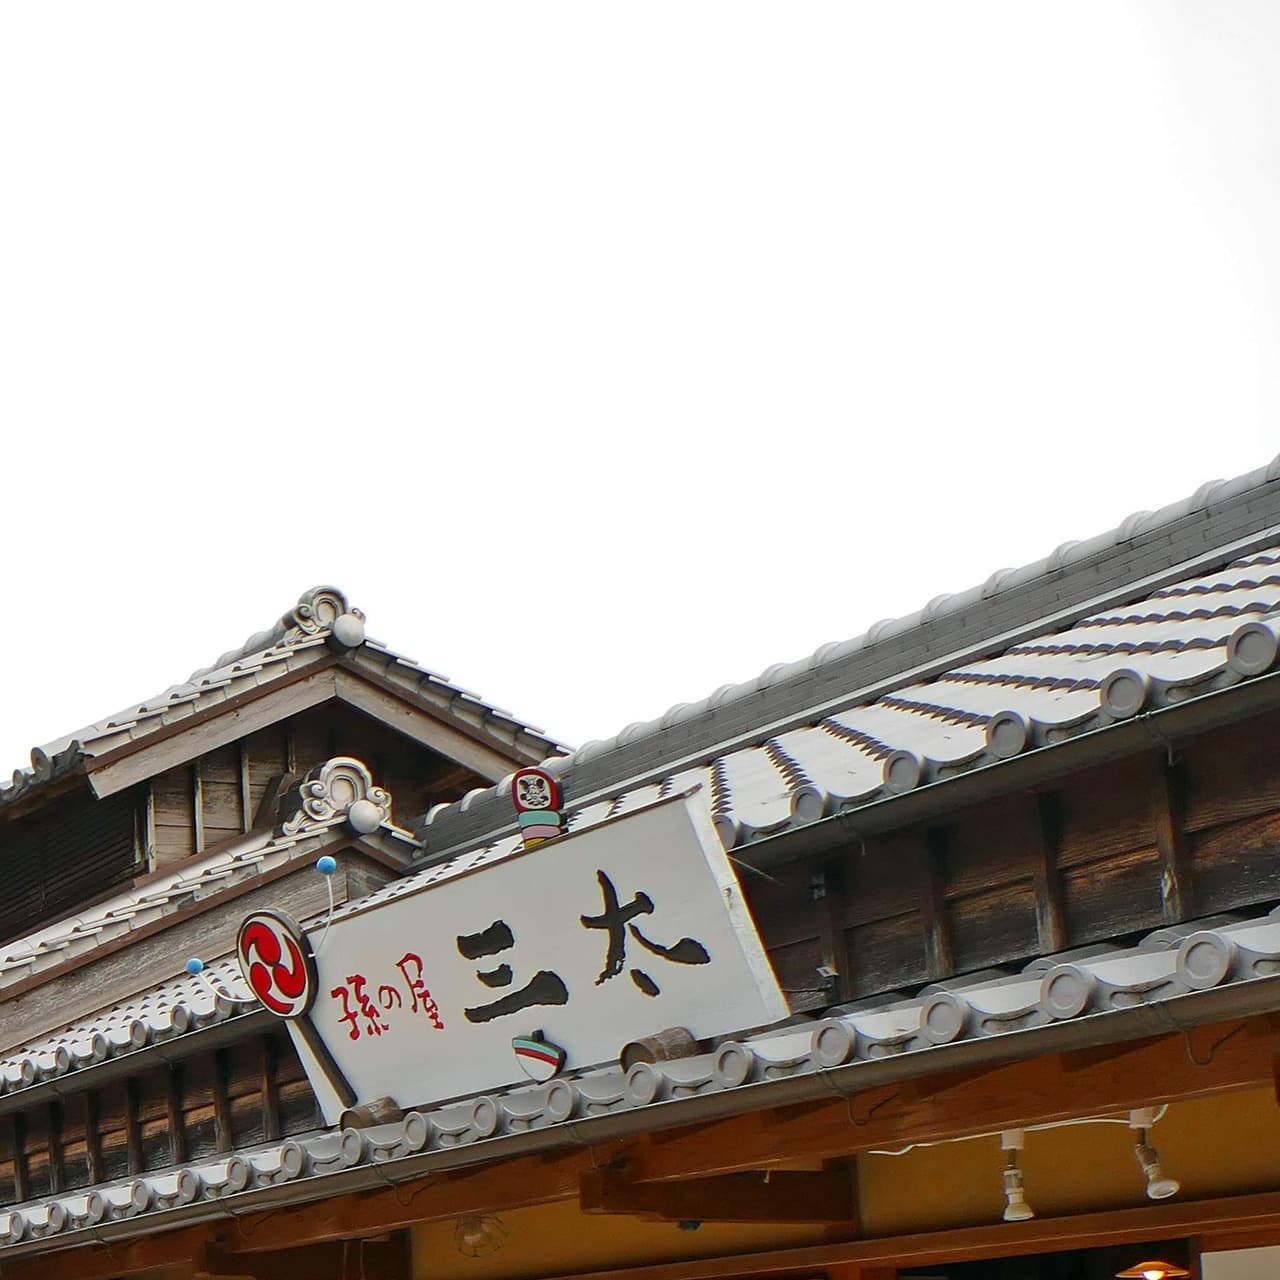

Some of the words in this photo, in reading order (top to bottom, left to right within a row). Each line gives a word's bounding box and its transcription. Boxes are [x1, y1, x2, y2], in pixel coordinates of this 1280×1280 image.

[330, 952, 446, 1041] 孫の屋
[456, 868, 711, 1024] 三太
